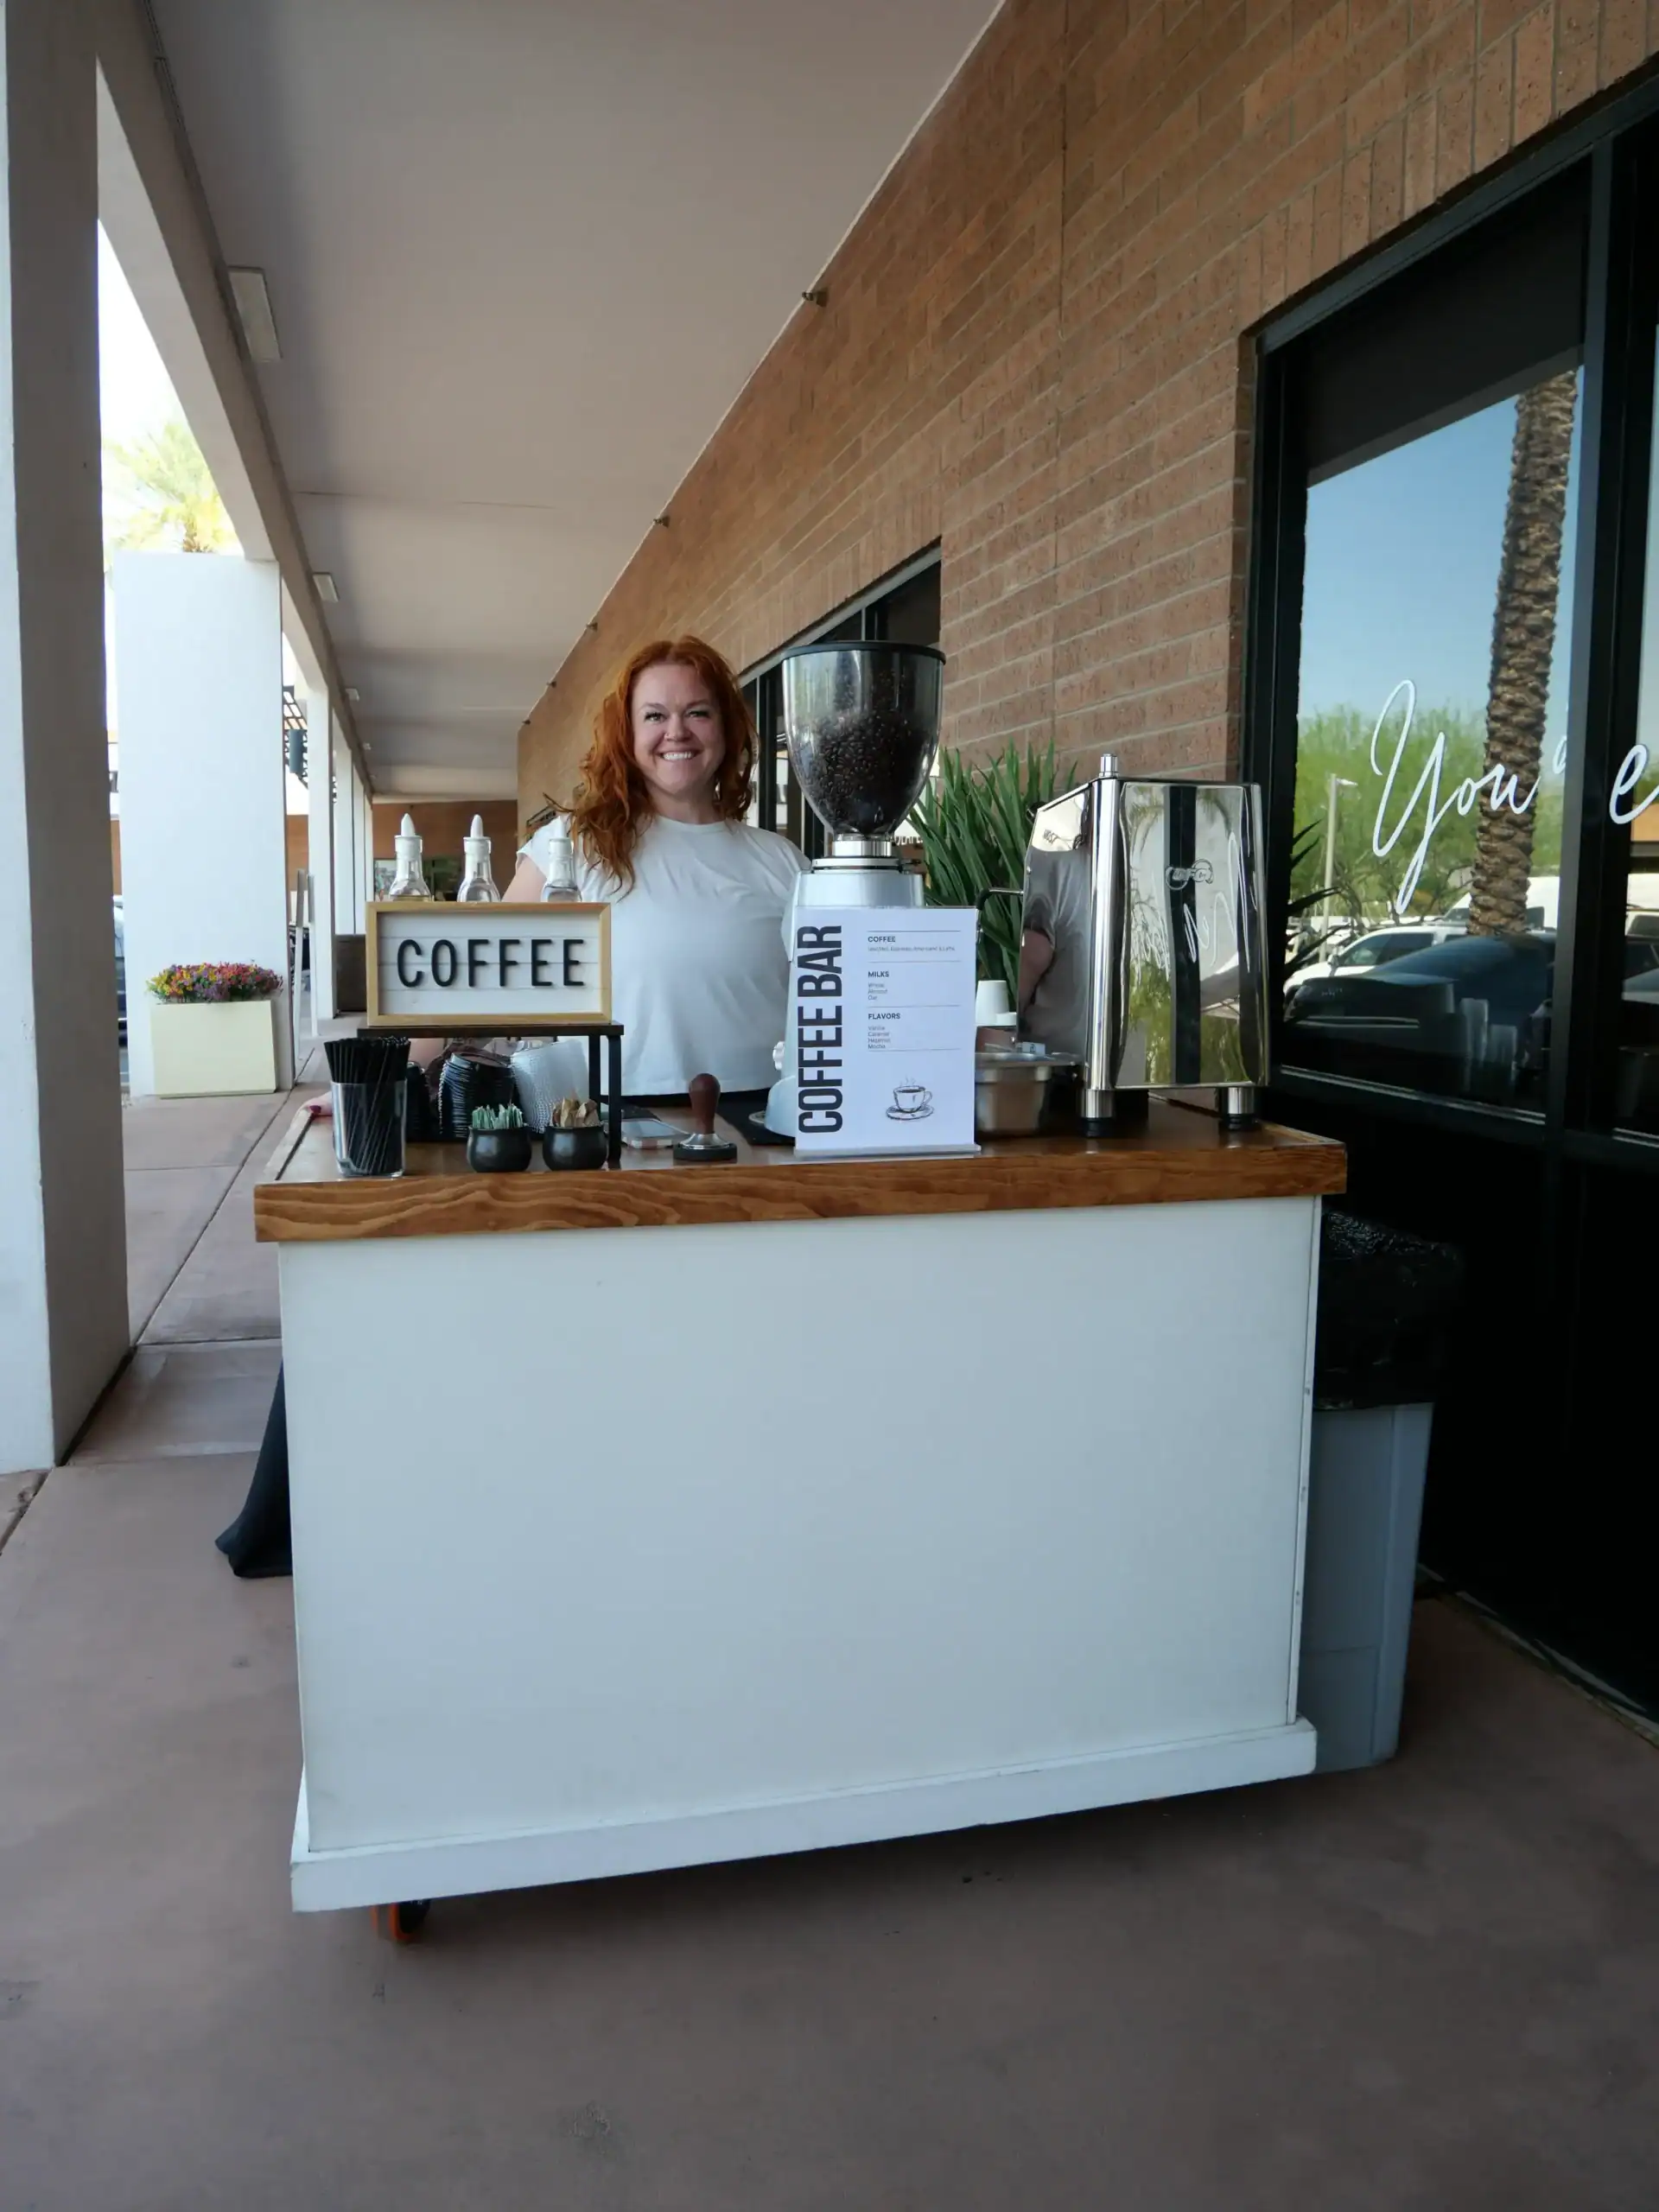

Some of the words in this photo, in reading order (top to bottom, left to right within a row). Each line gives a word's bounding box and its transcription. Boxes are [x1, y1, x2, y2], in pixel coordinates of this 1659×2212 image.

[397, 938, 585, 987] COFFEE
[797, 925, 842, 997] BAR
[798, 1005, 842, 1133] COFFEE
